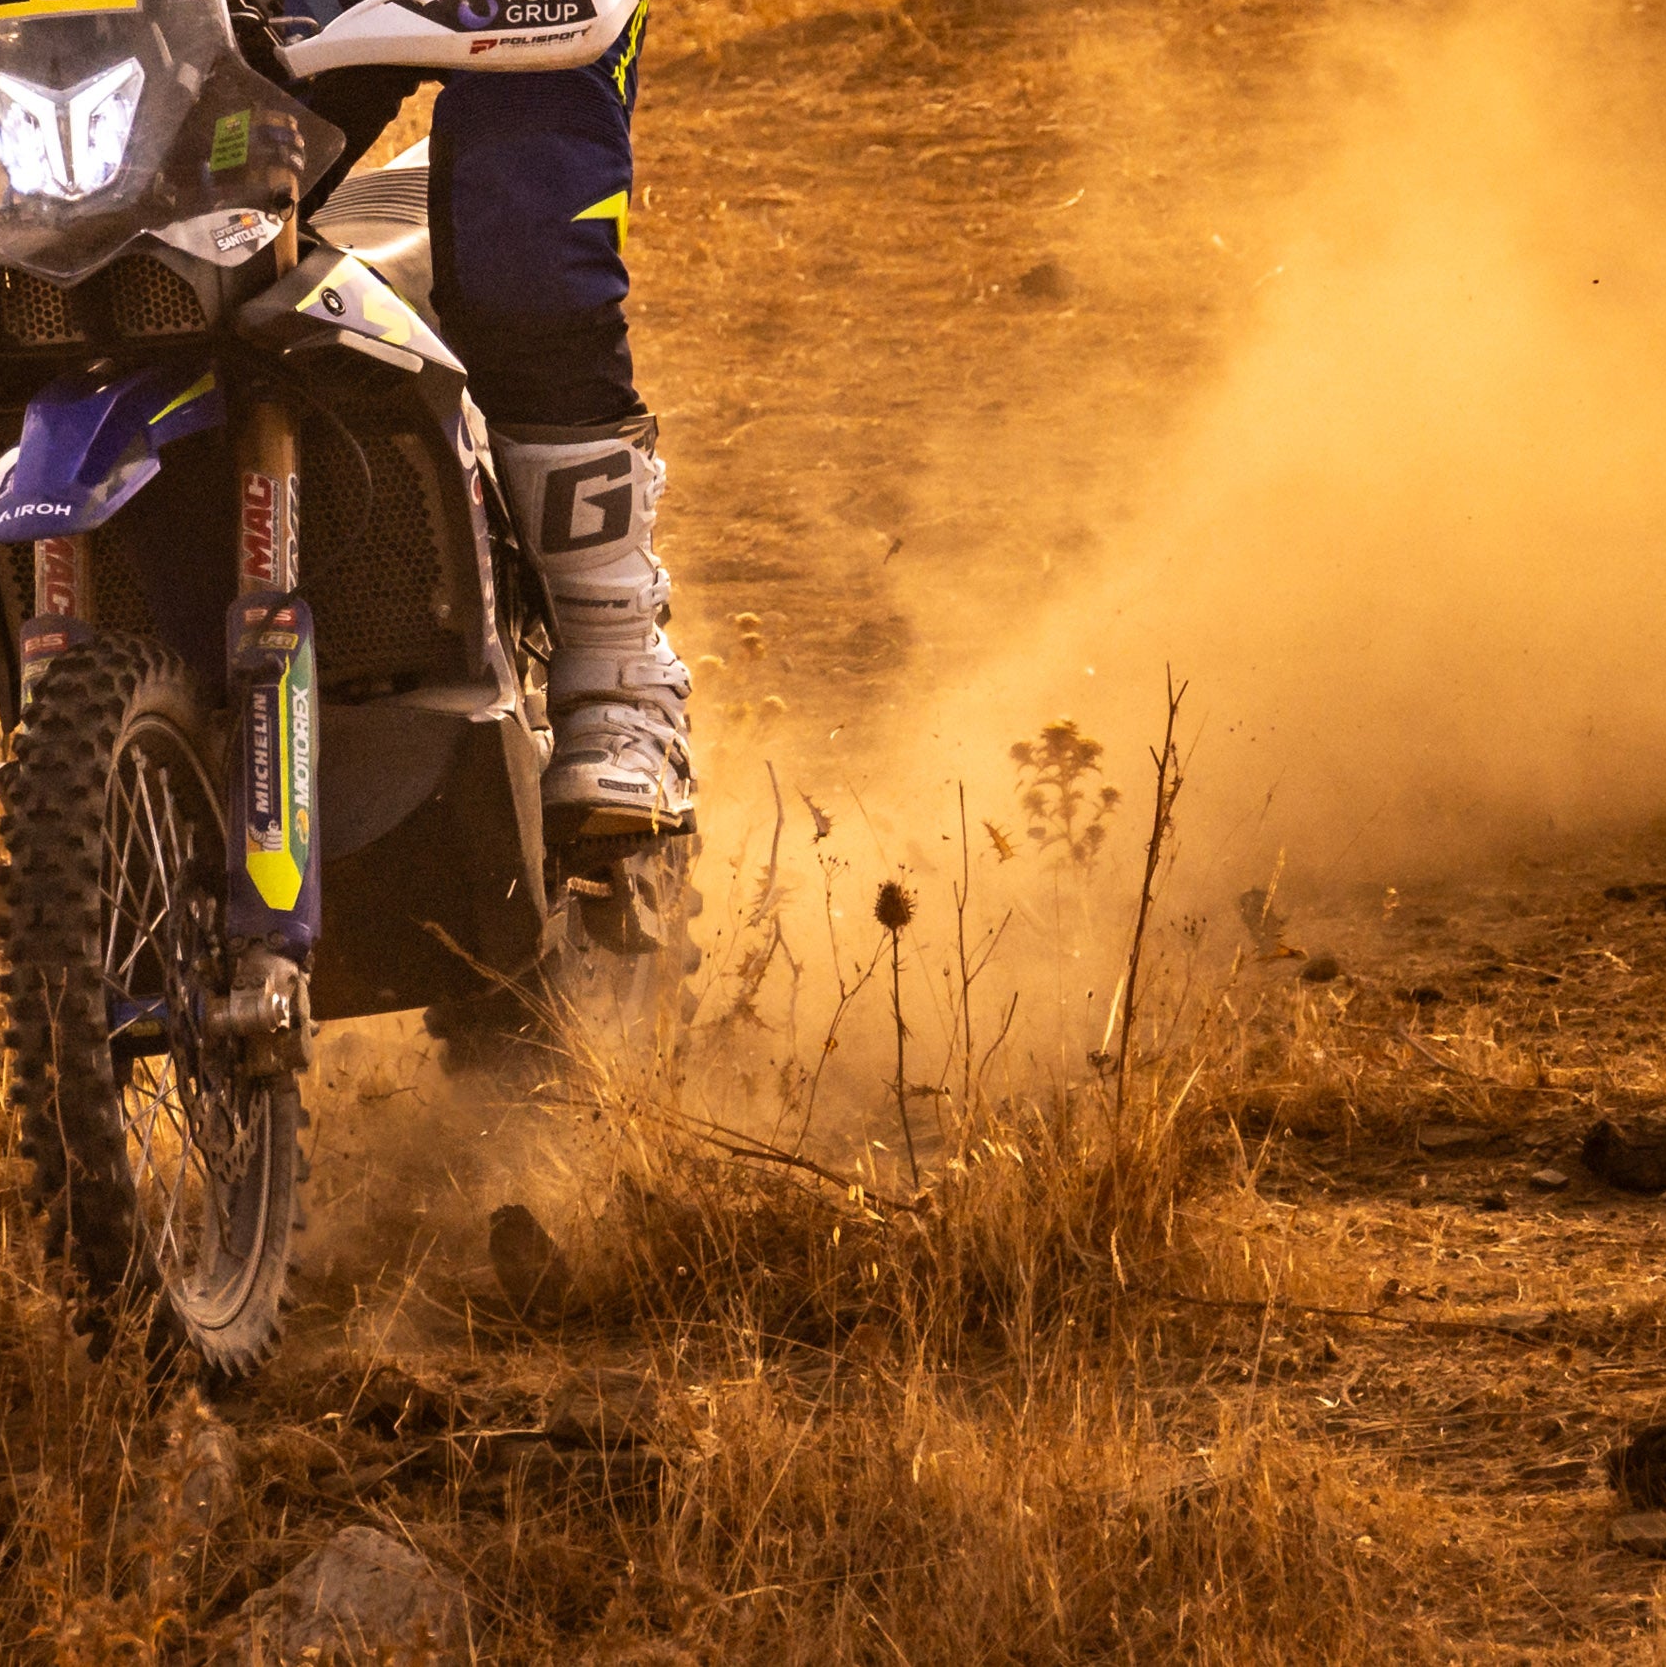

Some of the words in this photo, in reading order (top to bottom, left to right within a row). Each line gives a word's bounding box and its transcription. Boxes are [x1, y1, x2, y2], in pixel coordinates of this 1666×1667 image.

[506, 3, 578, 23] GRUP
[243, 472, 272, 580] MAC
[252, 693, 270, 814] MICHELIN
[292, 684, 310, 808] MOTOREX
